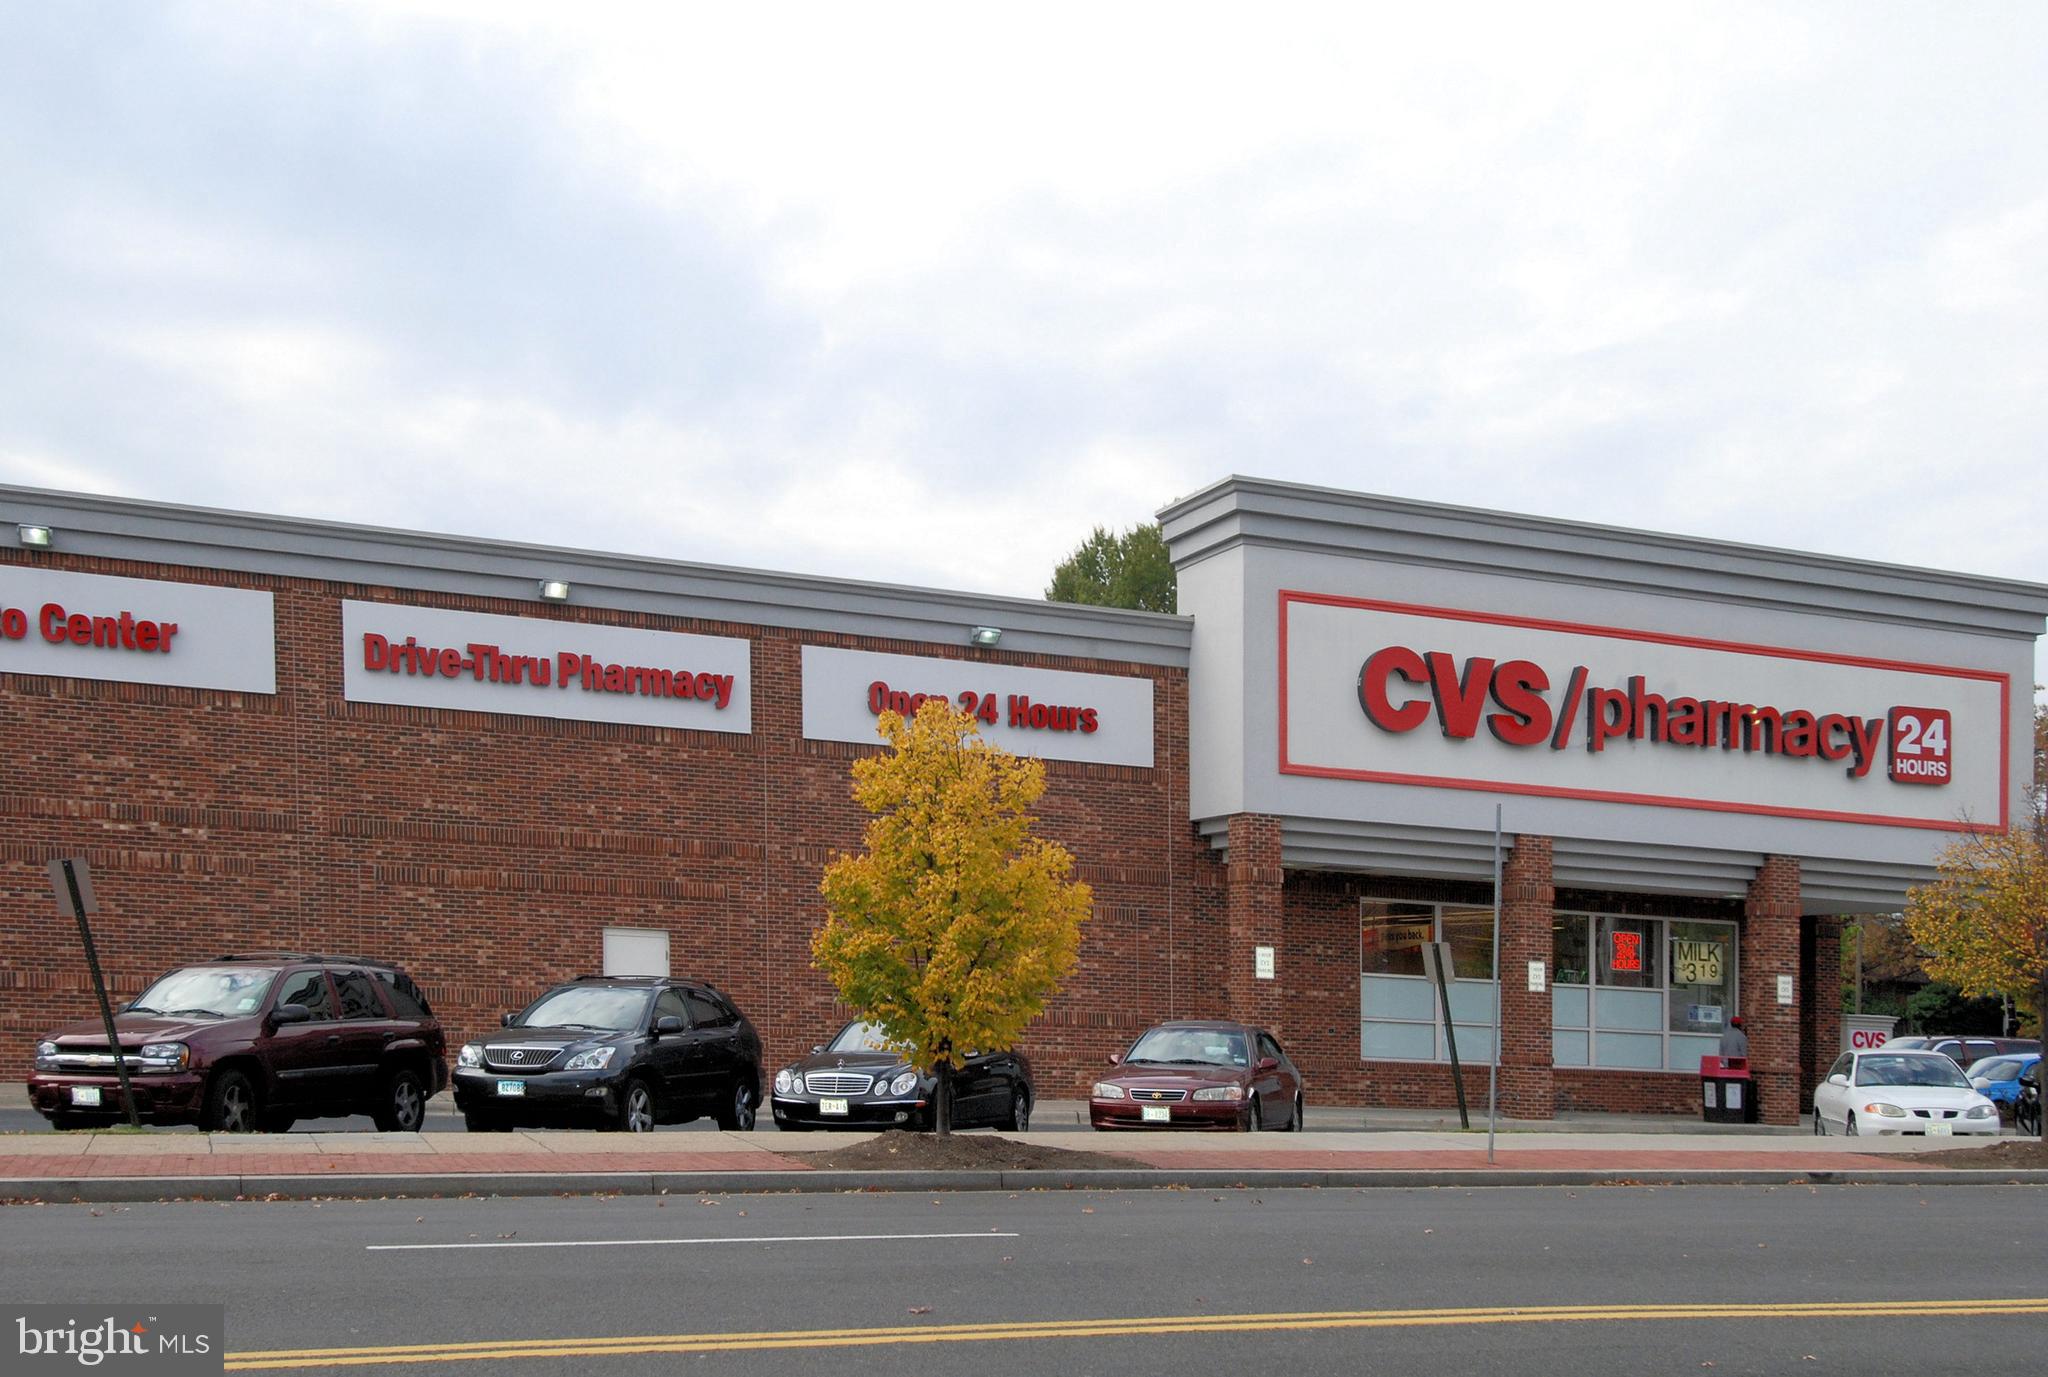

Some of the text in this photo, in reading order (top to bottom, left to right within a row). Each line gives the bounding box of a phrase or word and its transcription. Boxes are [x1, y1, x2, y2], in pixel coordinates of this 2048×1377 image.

[39, 602, 178, 653] Center
[363, 632, 734, 709] Drive-Thru Pharmacy
[867, 681, 1099, 734] Ope 24 Hours
[1357, 645, 1884, 778] CVS/pharmacy
[1897, 715, 1946, 756] 24
[1896, 758, 1947, 777] HOURS
[1613, 932, 1640, 945] OPEN
[1678, 942, 1719, 962] MILK
[1611, 958, 1640, 970] HOURS
[1852, 1030, 1886, 1049] CVS
